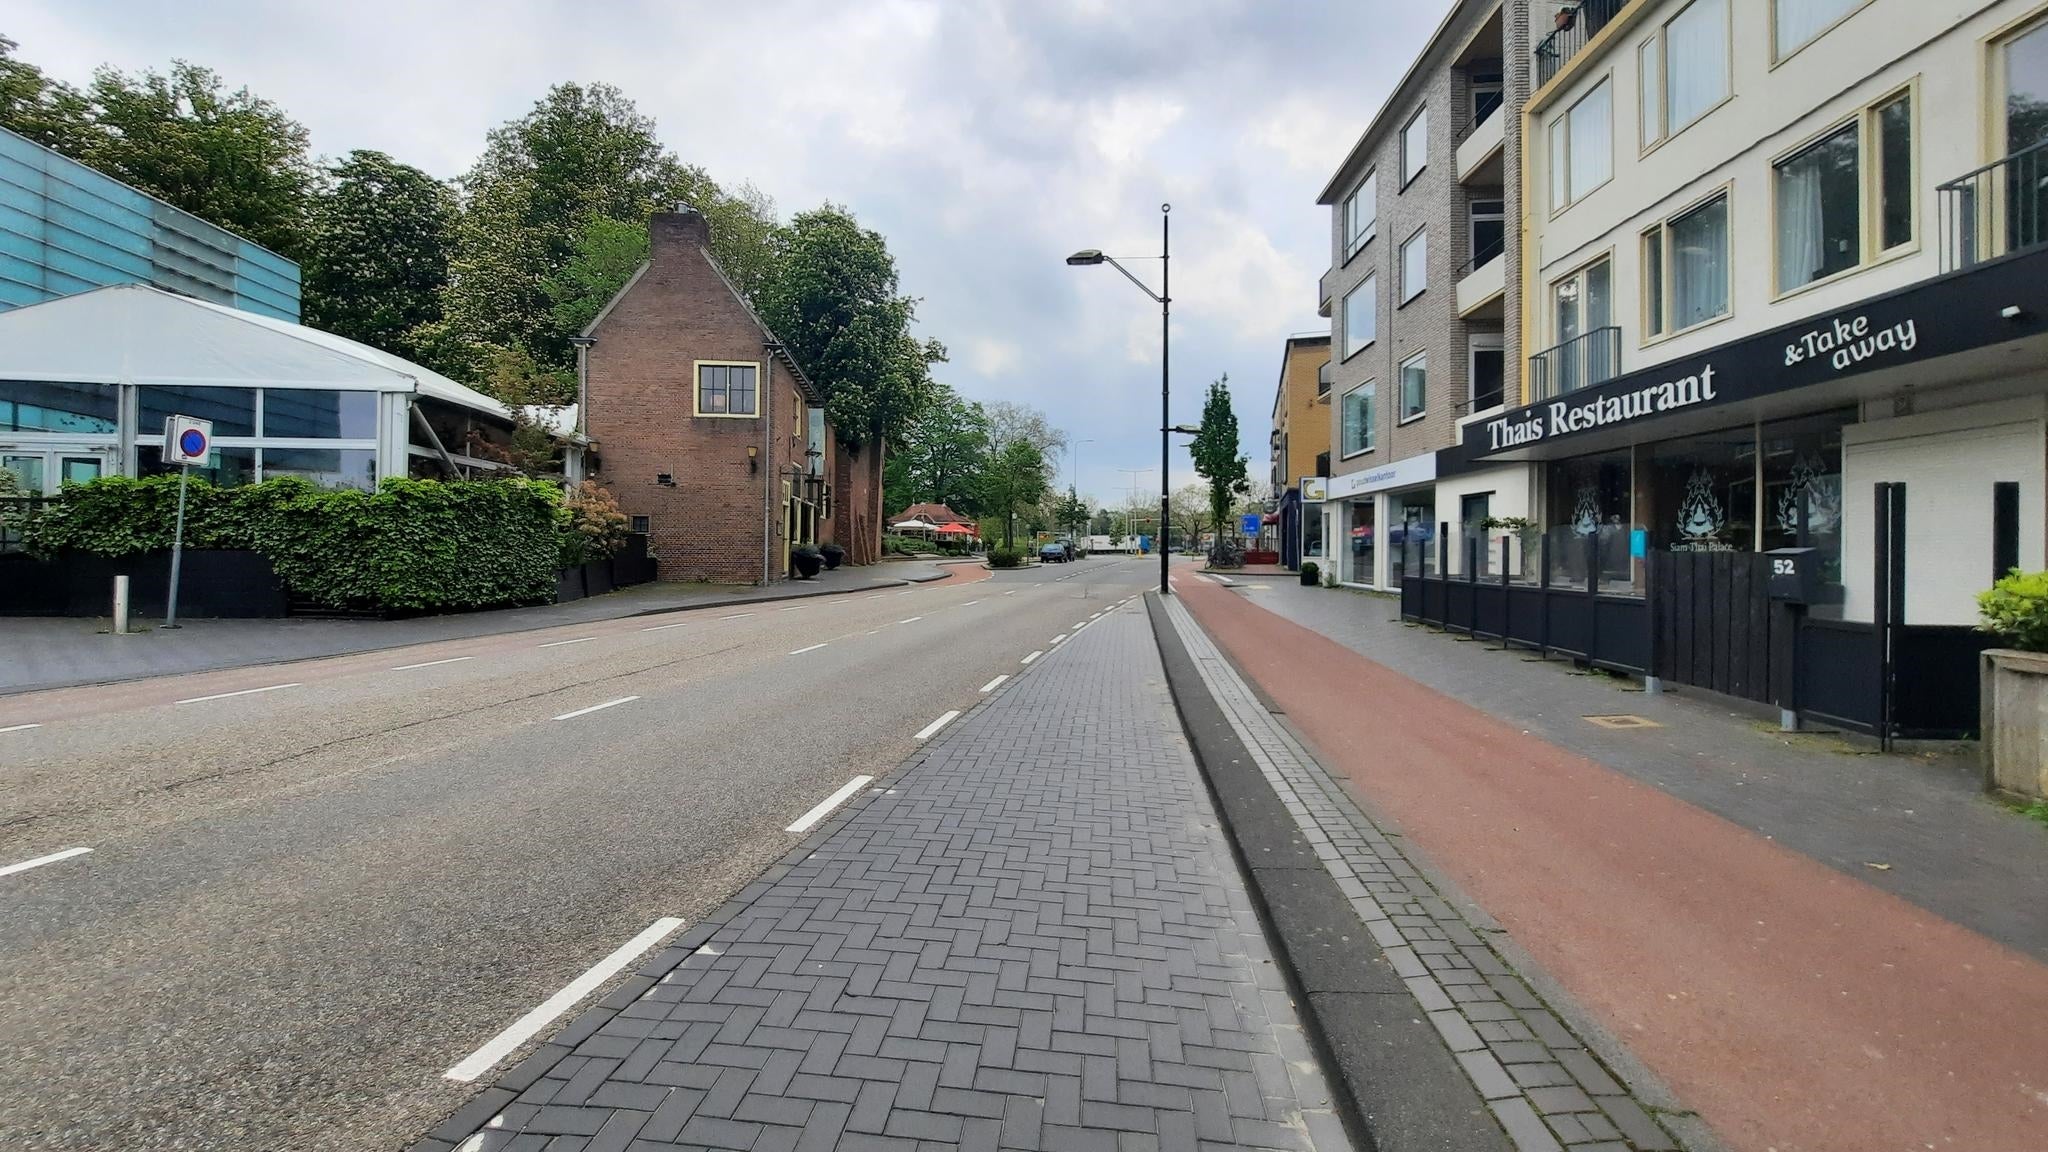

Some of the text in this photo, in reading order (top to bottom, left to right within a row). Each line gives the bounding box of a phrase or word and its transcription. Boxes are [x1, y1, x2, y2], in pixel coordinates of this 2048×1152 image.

[1784, 315, 1869, 366] &Take
[1832, 319, 1917, 370] away
[1487, 363, 1717, 450] Thais Restaurant
[1302, 479, 1325, 500] G
[1670, 541, 1734, 552] Siam Thai Palace
[1773, 558, 1795, 575] 52
